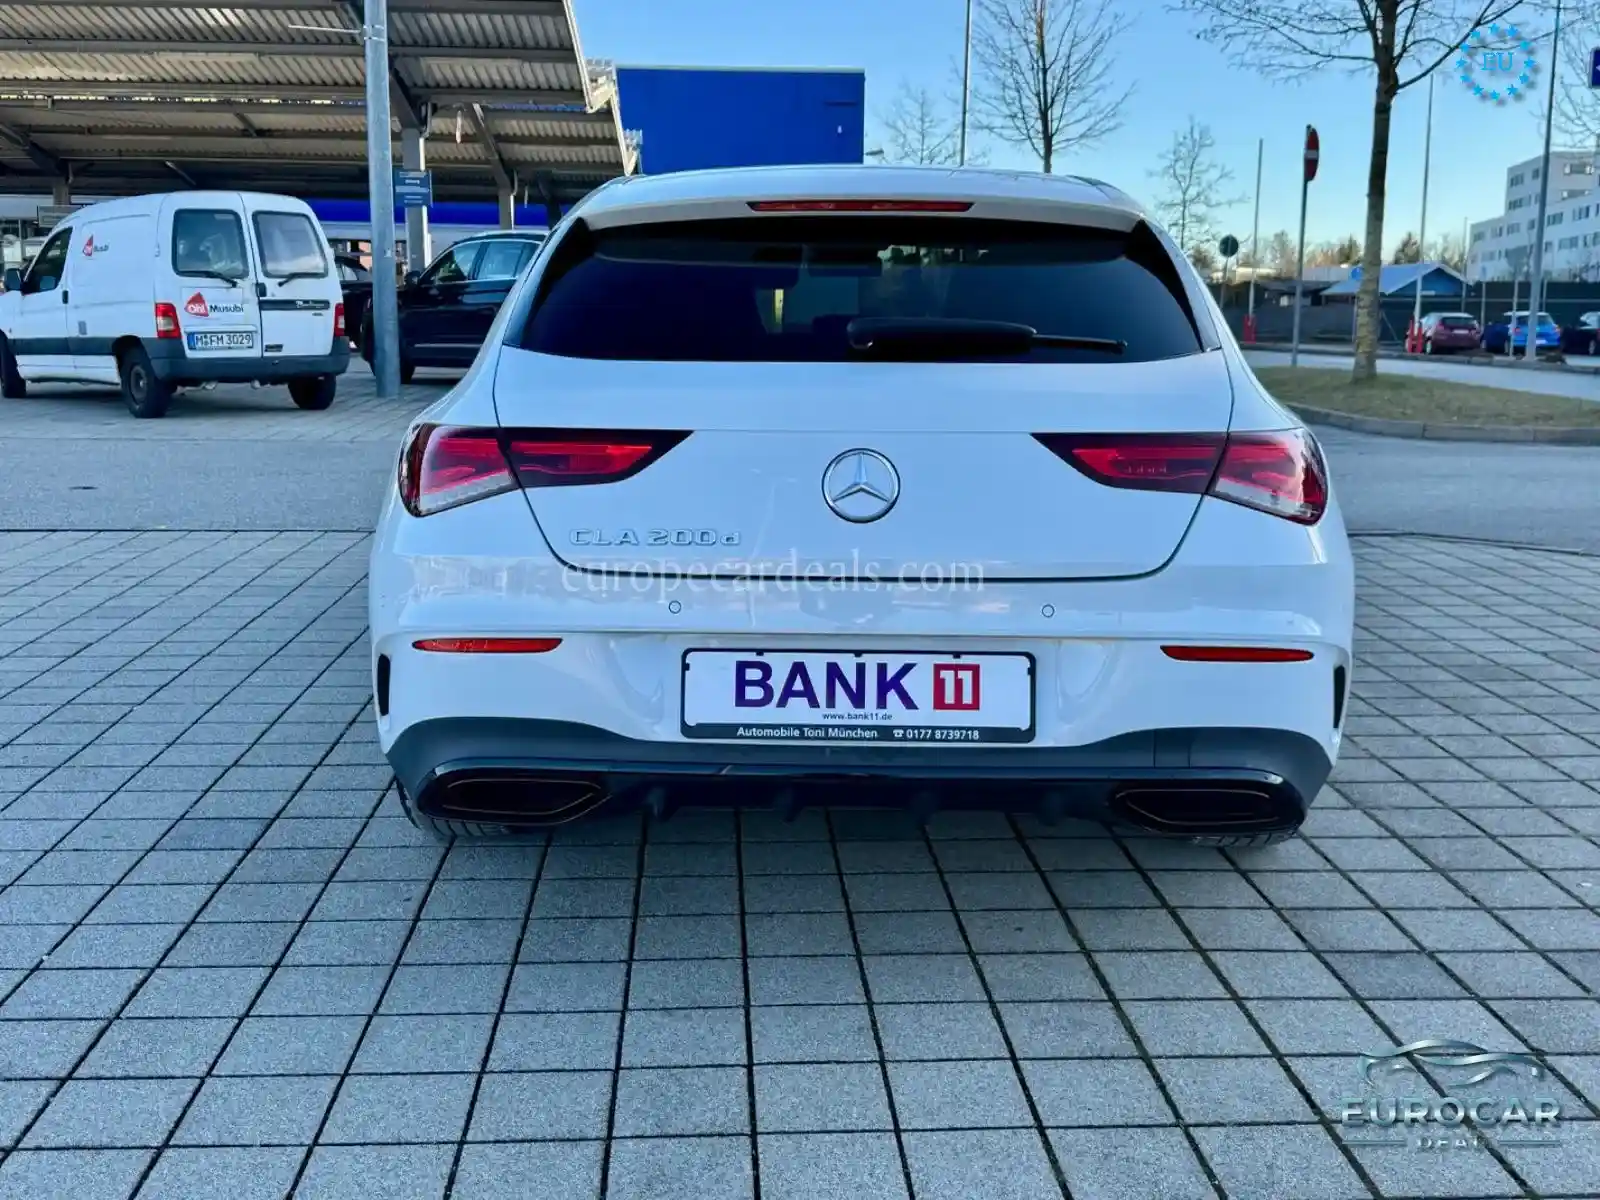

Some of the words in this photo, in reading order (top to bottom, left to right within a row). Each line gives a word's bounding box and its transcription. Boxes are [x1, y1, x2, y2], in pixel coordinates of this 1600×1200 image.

[209, 303, 244, 313] Musubi
[226, 332, 251, 345] 3029
[569, 529, 639, 546] CLA
[735, 660, 919, 710] BANK
[939, 669, 975, 705] 11
[822, 711, 893, 721] www.bank11.de
[737, 726, 800, 738] Automobile
[803, 727, 825, 738] Toni
[828, 727, 878, 738] München
[906, 729, 932, 739] 0177
[935, 729, 980, 740] 8739718
